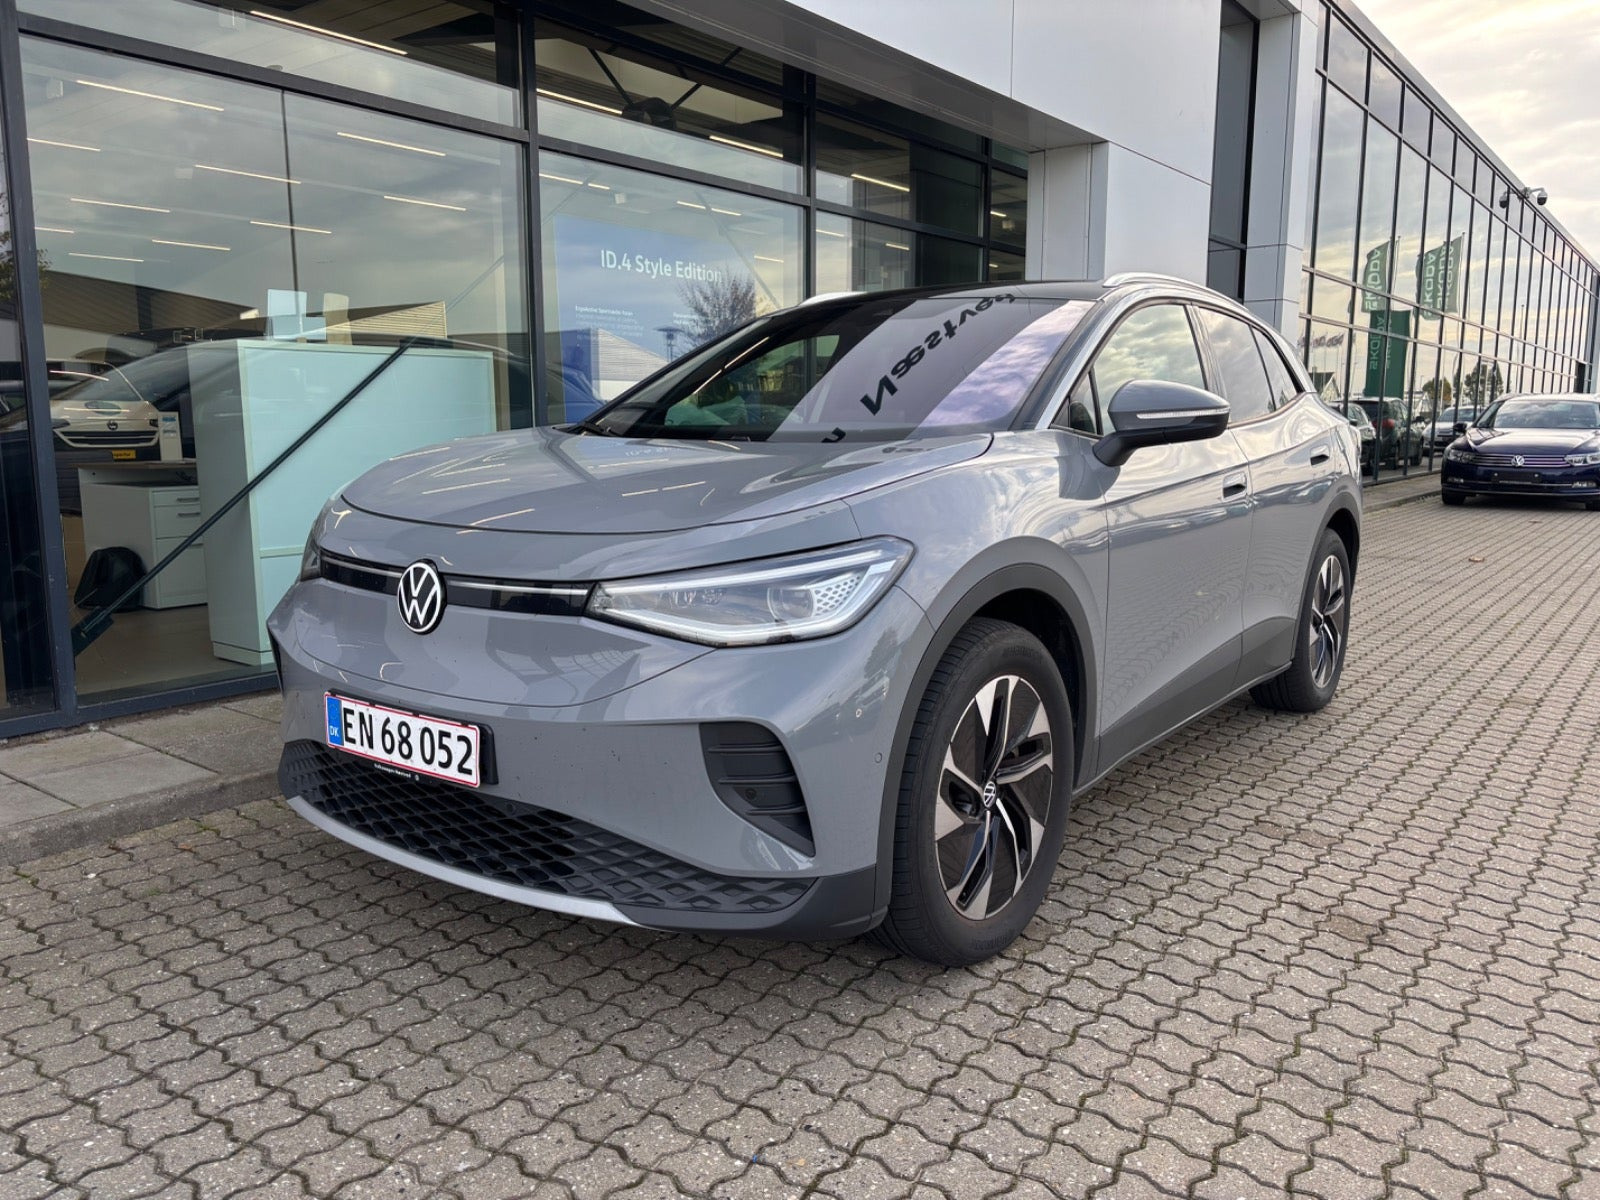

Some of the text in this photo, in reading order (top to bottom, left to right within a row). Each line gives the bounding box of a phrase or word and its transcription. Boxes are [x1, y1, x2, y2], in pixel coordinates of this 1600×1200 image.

[601, 250, 722, 283] ID.4 Style Edition
[329, 725, 340, 738] DK
[343, 708, 473, 776] EN 68 052
